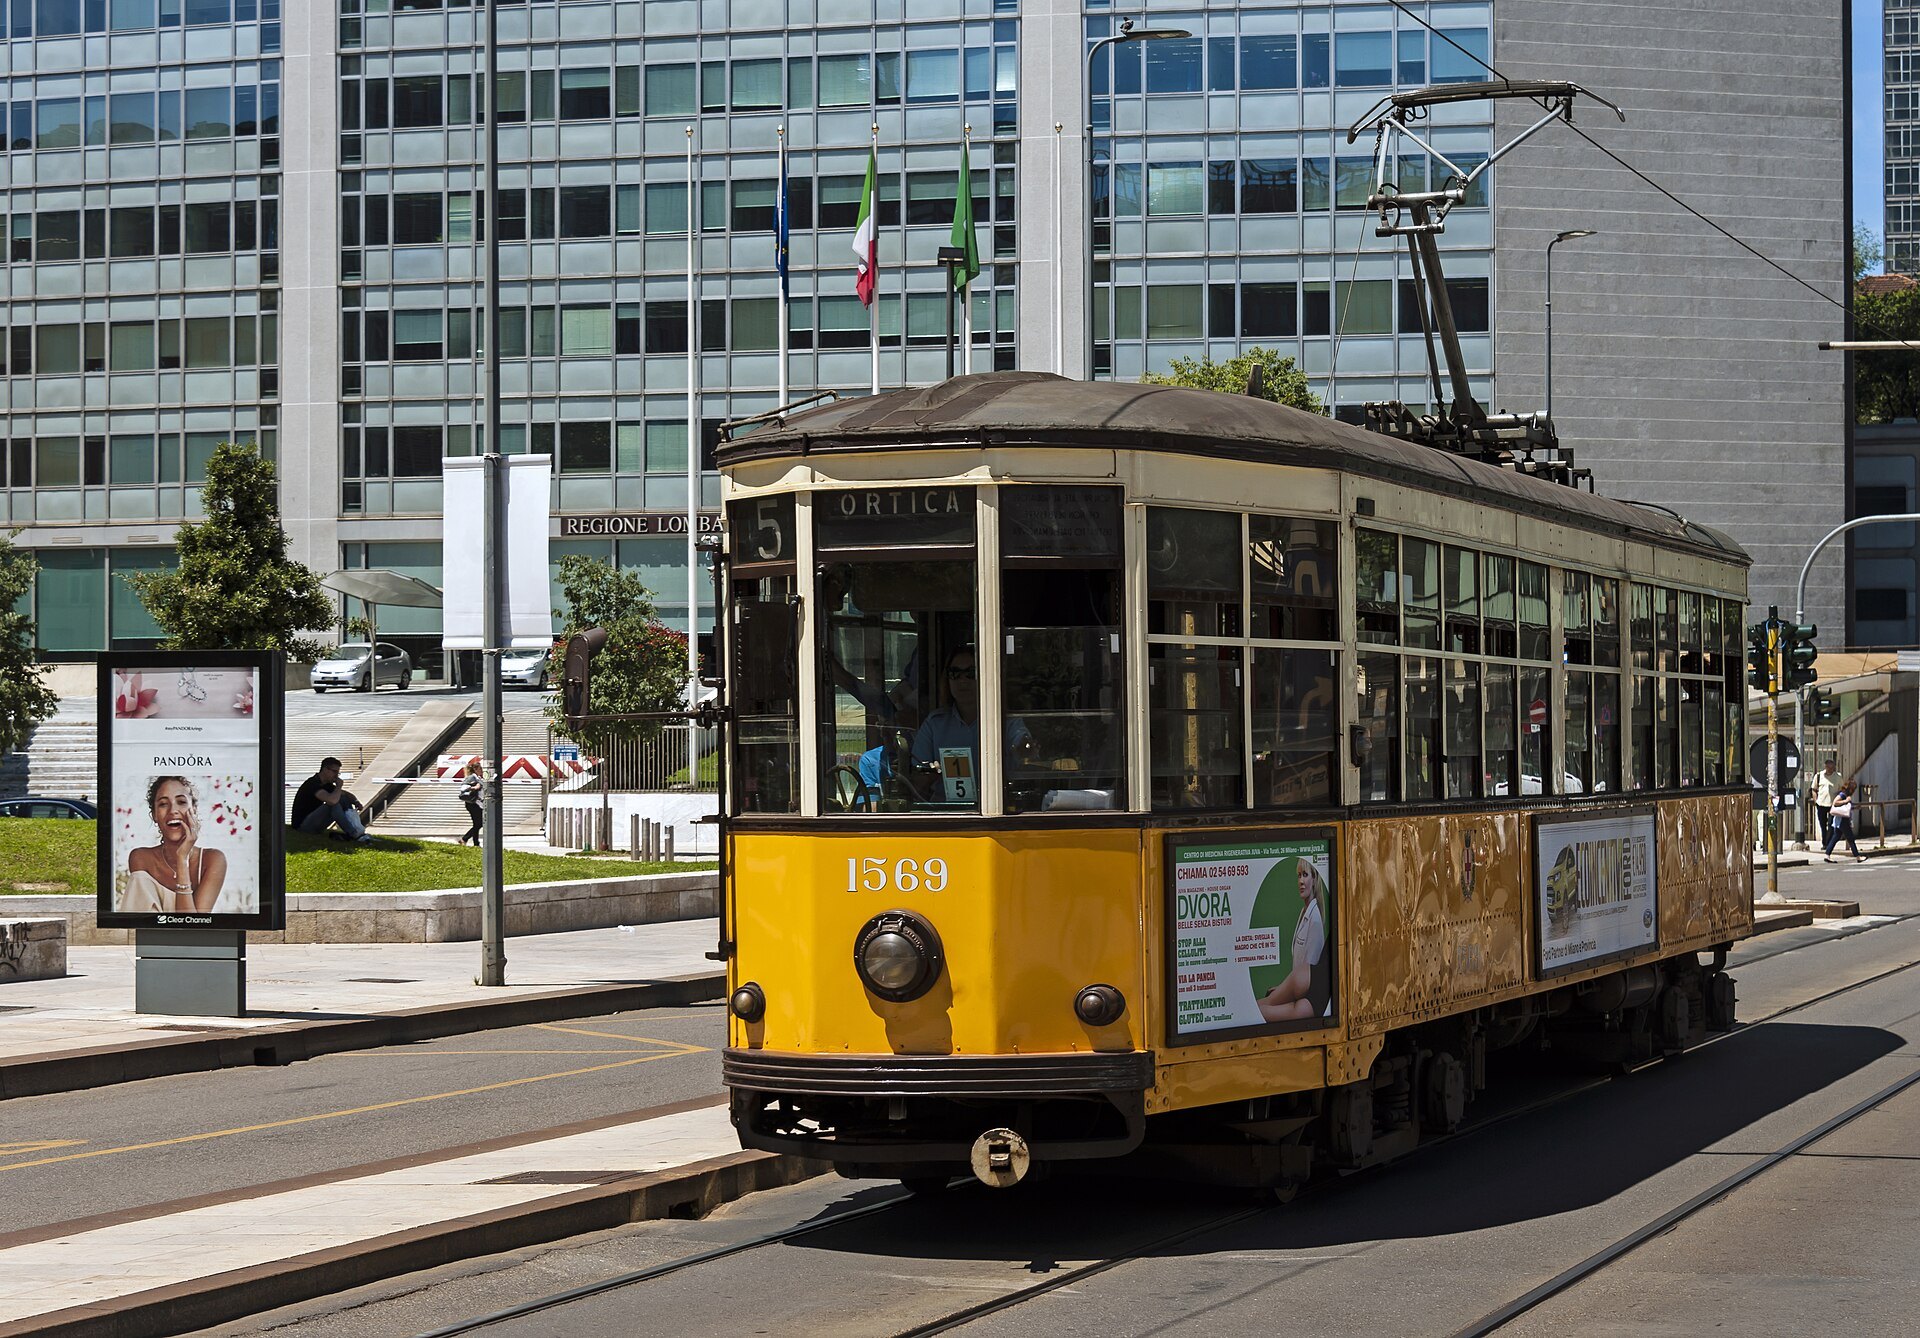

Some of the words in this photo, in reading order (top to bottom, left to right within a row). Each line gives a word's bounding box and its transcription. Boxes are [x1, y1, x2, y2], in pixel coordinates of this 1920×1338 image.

[840, 490, 960, 516] ORTICA
[567, 517, 649, 534] REGIONE
[757, 499, 782, 560] 5
[952, 758, 961, 777] 1
[955, 780, 966, 798] 5
[846, 857, 949, 893] 1569
[1177, 866, 1208, 880] CHIAMA
[1208, 866, 1217, 878] 02
[1218, 866, 1227, 877] 54
[1227, 865, 1236, 877] 69
[1236, 864, 1249, 876] 593
[1623, 837, 1632, 900] FORD
[1178, 892, 1232, 920] DVORA
[167, 916, 185, 924] Clear
[185, 916, 212, 924] Channel
[1178, 920, 1194, 930] BELLE
[1194, 919, 1212, 928] SENZA
[1212, 917, 1232, 927] BISTURI
[1178, 938, 1192, 949] STOP
[1192, 937, 1207, 947] ALLA
[1254, 933, 1271, 941] SVEGLIA
[1178, 947, 1207, 959] CELLULITE
[1234, 943, 1250, 951] MAGRO
[1250, 942, 1258, 950] CHE
[1178, 974, 1188, 984] VIA
[1188, 973, 1196, 983] LA
[1196, 971, 1216, 982] PANCIA
[1178, 996, 1226, 1012] TRATTAMENTO
[1178, 1012, 1204, 1026] GLUTEO
